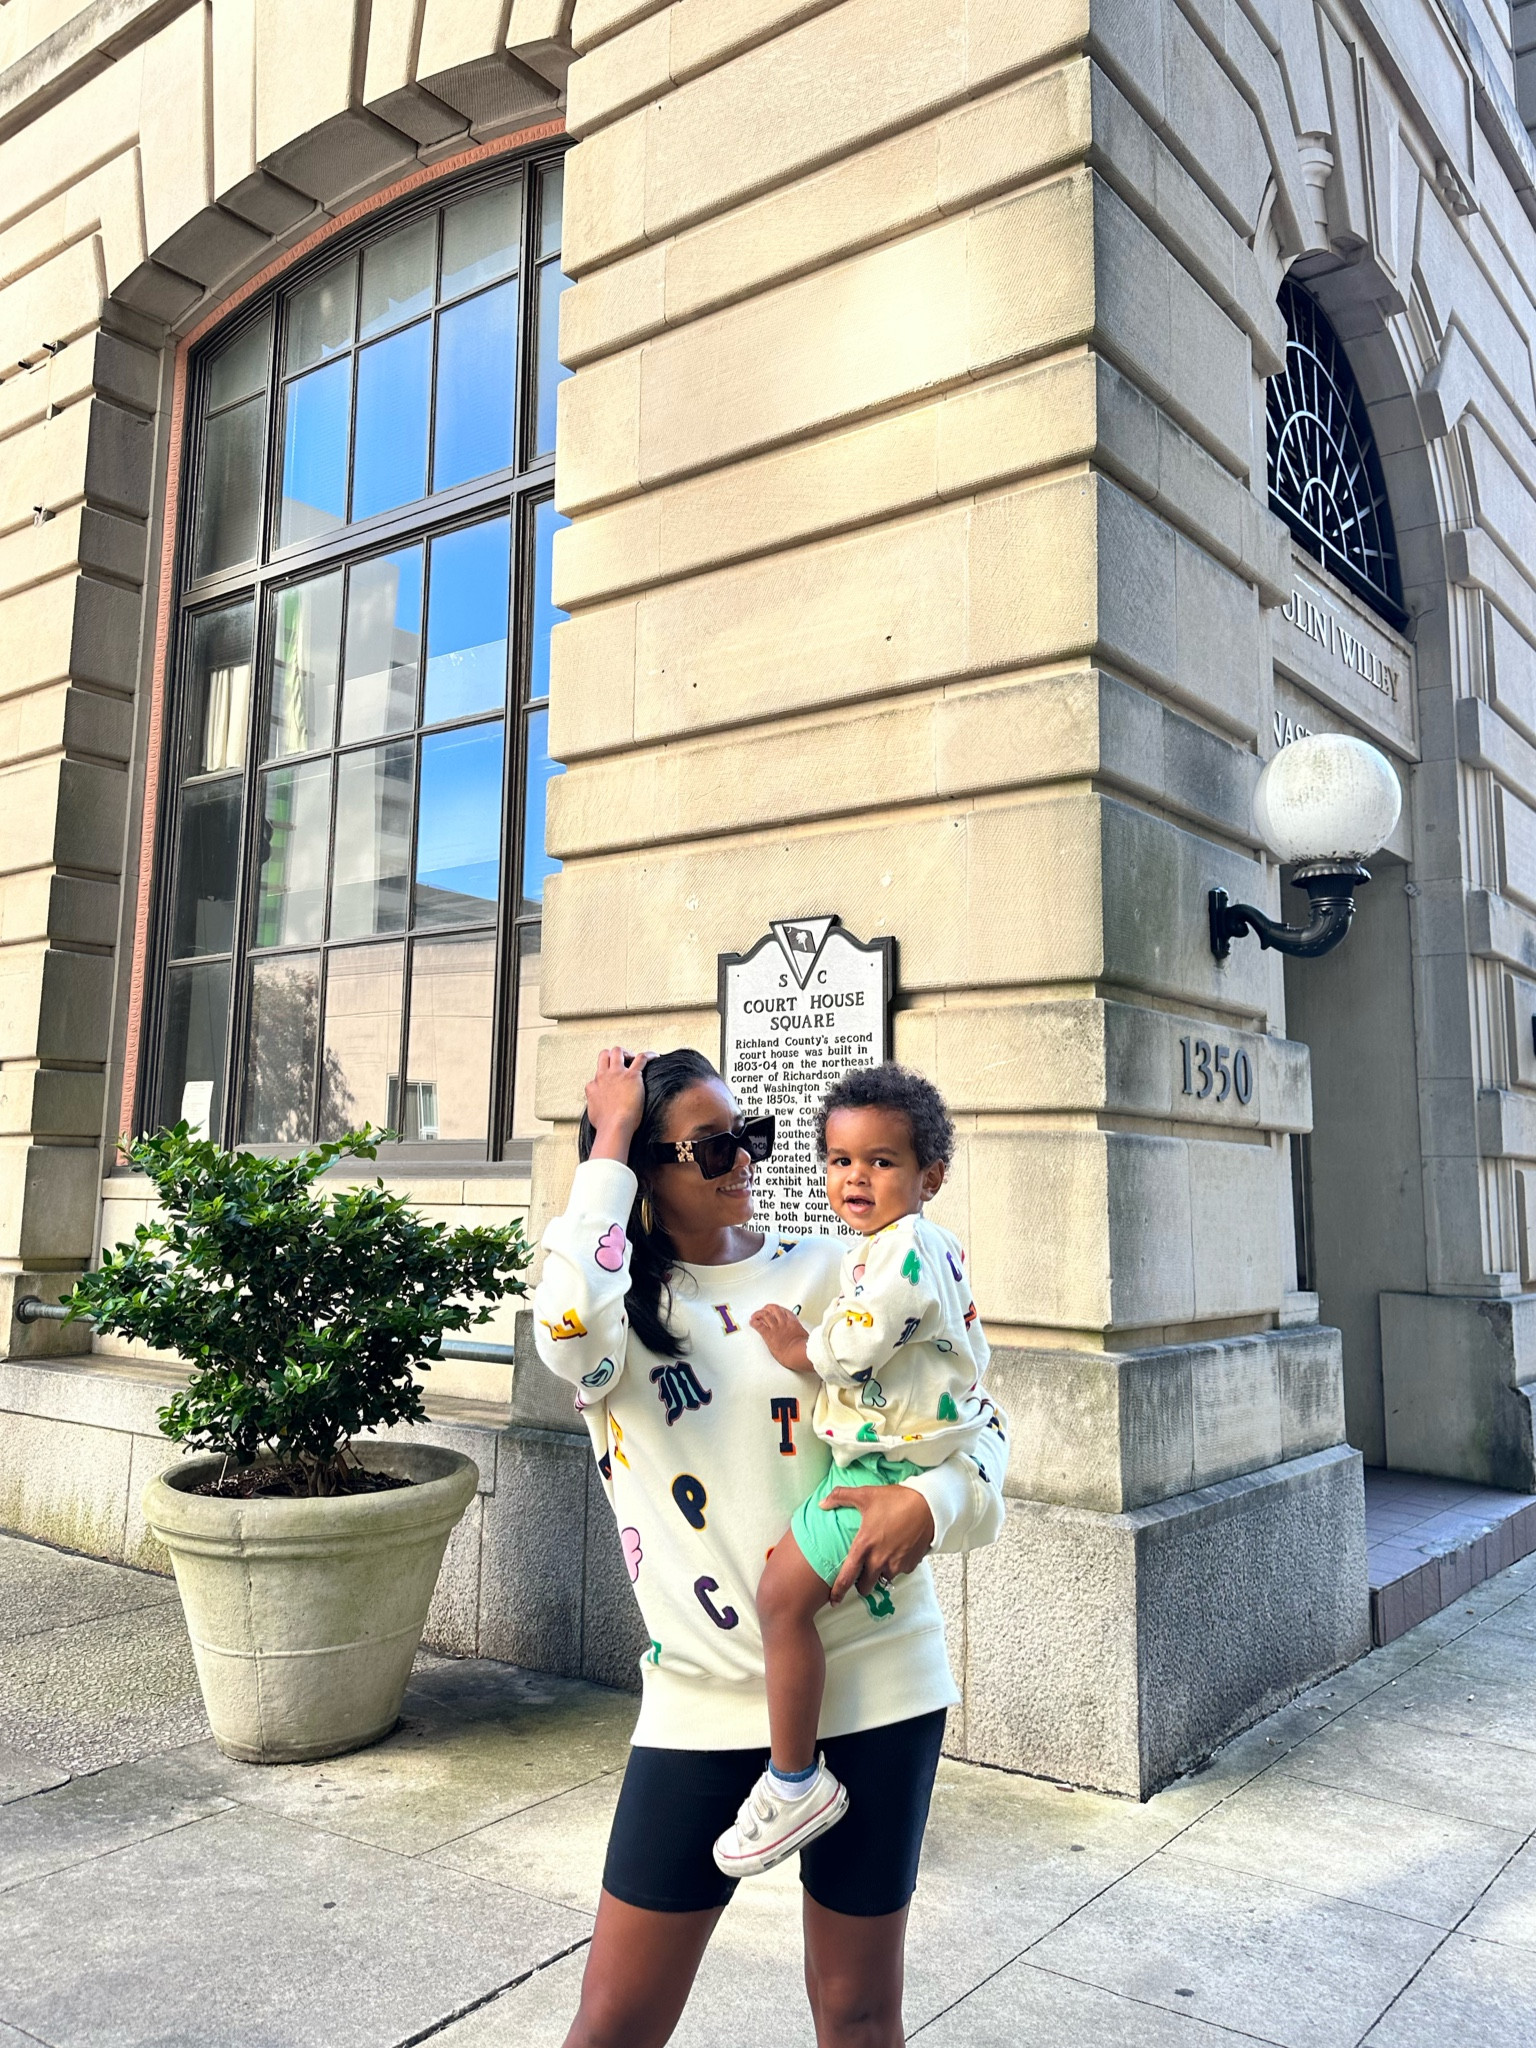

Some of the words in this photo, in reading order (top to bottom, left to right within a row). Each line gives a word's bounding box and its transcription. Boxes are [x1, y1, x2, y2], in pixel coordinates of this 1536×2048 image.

[1337, 626, 1399, 703] WILLEY
[778, 974, 788, 988] S
[817, 970, 827, 984] C
[743, 997, 797, 1014] COURT
[810, 991, 865, 1009] HOUSE
[770, 1012, 835, 1031] SQUARE
[735, 1038, 779, 1050] Richland
[785, 1035, 829, 1047] County's
[834, 1032, 873, 1044] second
[740, 1050, 766, 1060] court
[770, 1049, 799, 1059] house
[805, 1048, 823, 1057] was
[828, 1044, 852, 1056] built
[857, 1043, 868, 1054] in
[734, 1060, 777, 1072] 1803-04
[781, 1061, 794, 1070] on
[800, 1059, 817, 1068] the
[821, 1056, 874, 1068] northeast
[1179, 1036, 1253, 1105] 1350
[731, 1074, 763, 1083] corner
[768, 1072, 779, 1081] of
[783, 1070, 840, 1081] Richardson
[740, 1083, 758, 1094] and
[763, 1081, 820, 1095] Washington
[747, 1095, 763, 1104] the
[766, 1094, 798, 1105] 1850s,
[803, 1093, 812, 1103] it
[742, 1106, 759, 1116] and
[764, 1108, 770, 1116] a
[775, 1107, 794, 1116] new
[799, 1107, 821, 1116] cou
[779, 1119, 791, 1128] on
[797, 1117, 813, 1127] the
[776, 1130, 818, 1139] southea
[794, 1141, 811, 1151] the
[766, 1164, 817, 1174] contained
[765, 1175, 802, 1186] exhibit
[806, 1176, 826, 1186] hall
[783, 1188, 803, 1198] The
[759, 1200, 776, 1210] the
[780, 1201, 800, 1210] new
[804, 1201, 832, 1211] cour
[753, 1212, 770, 1221] ere
[775, 1212, 798, 1222] both
[778, 1224, 813, 1236] troops
[820, 1224, 829, 1235] in
[771, 1397, 800, 1457] T
[694, 1575, 739, 1631] C
